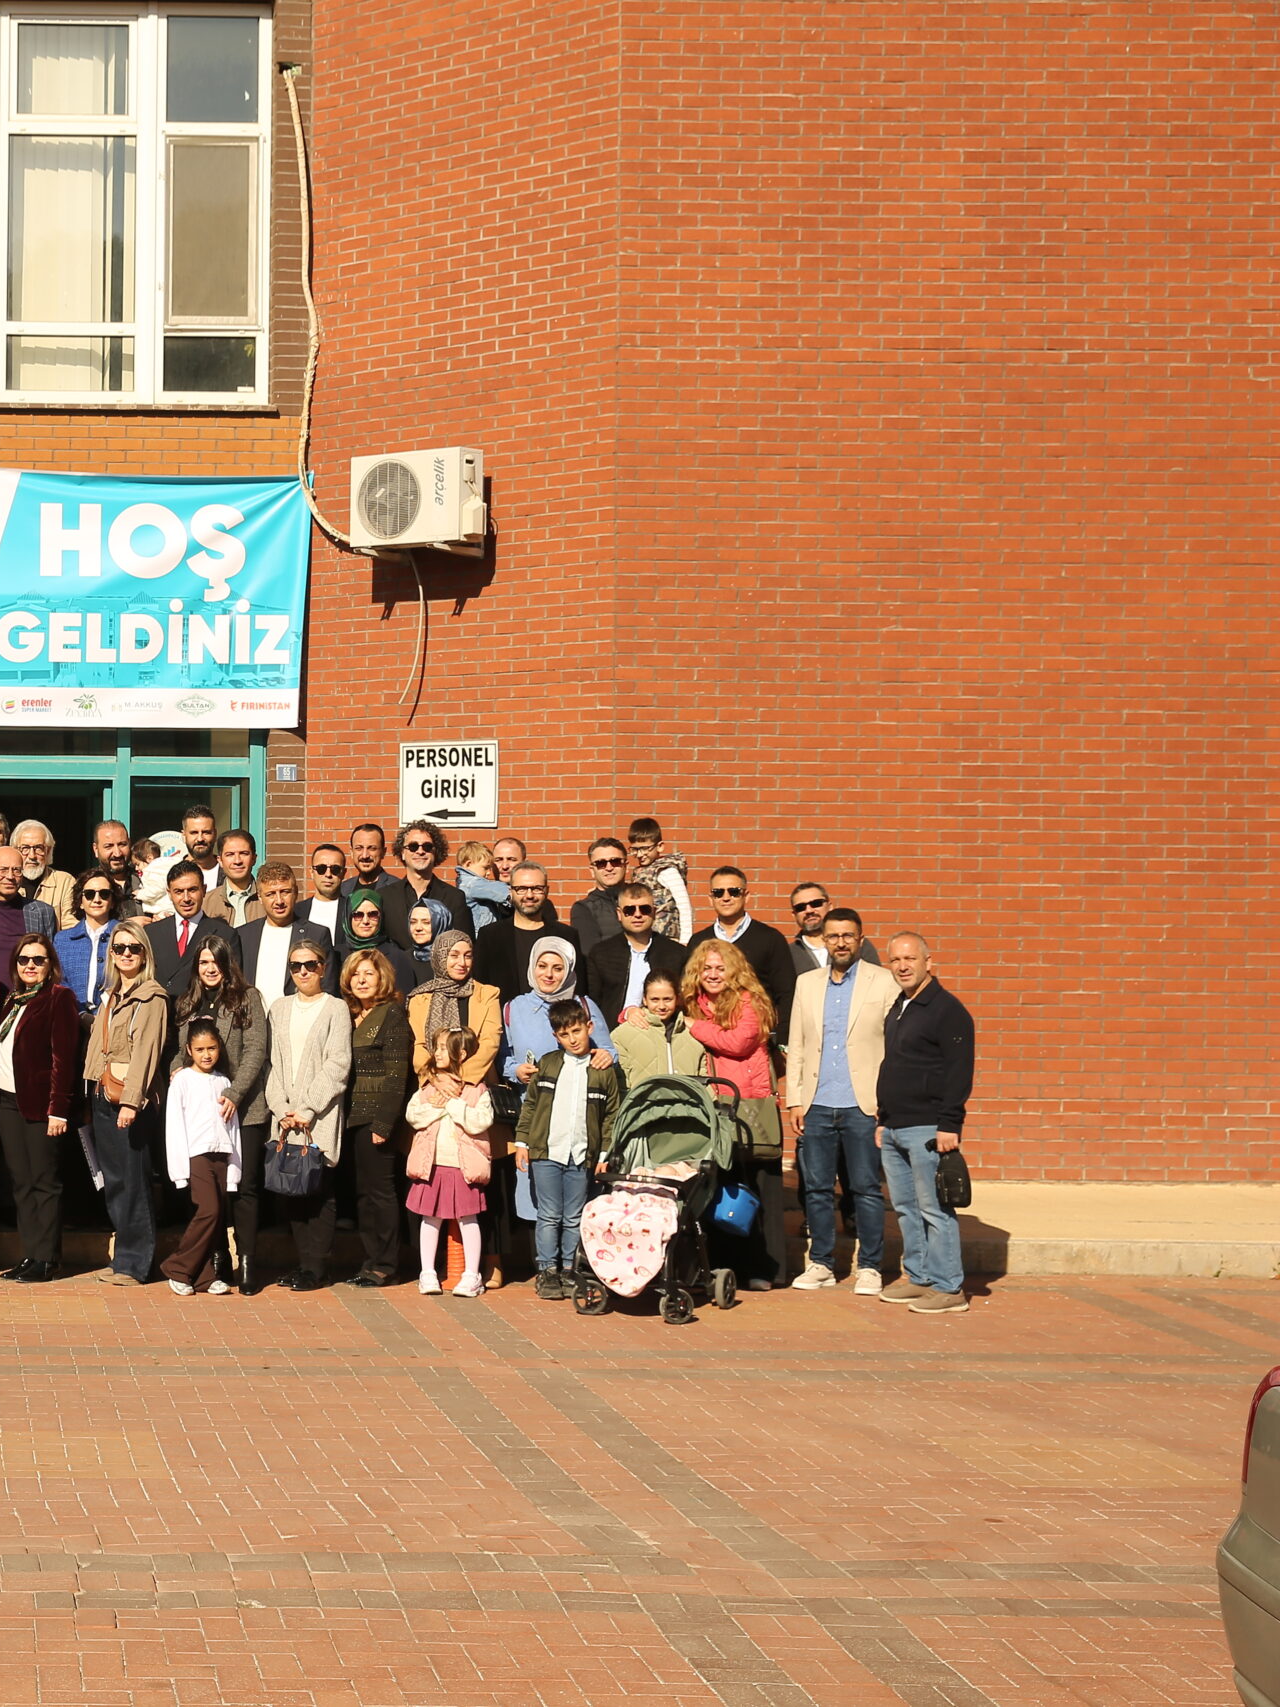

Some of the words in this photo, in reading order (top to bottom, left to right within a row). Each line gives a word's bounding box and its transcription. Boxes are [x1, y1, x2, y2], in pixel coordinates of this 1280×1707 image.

[433, 457, 446, 505] arçelik
[39, 502, 246, 602] HOŞ
[21, 697, 53, 707] erenler
[405, 746, 493, 769] PERSONEL
[420, 772, 476, 804] GİRİŞİ
